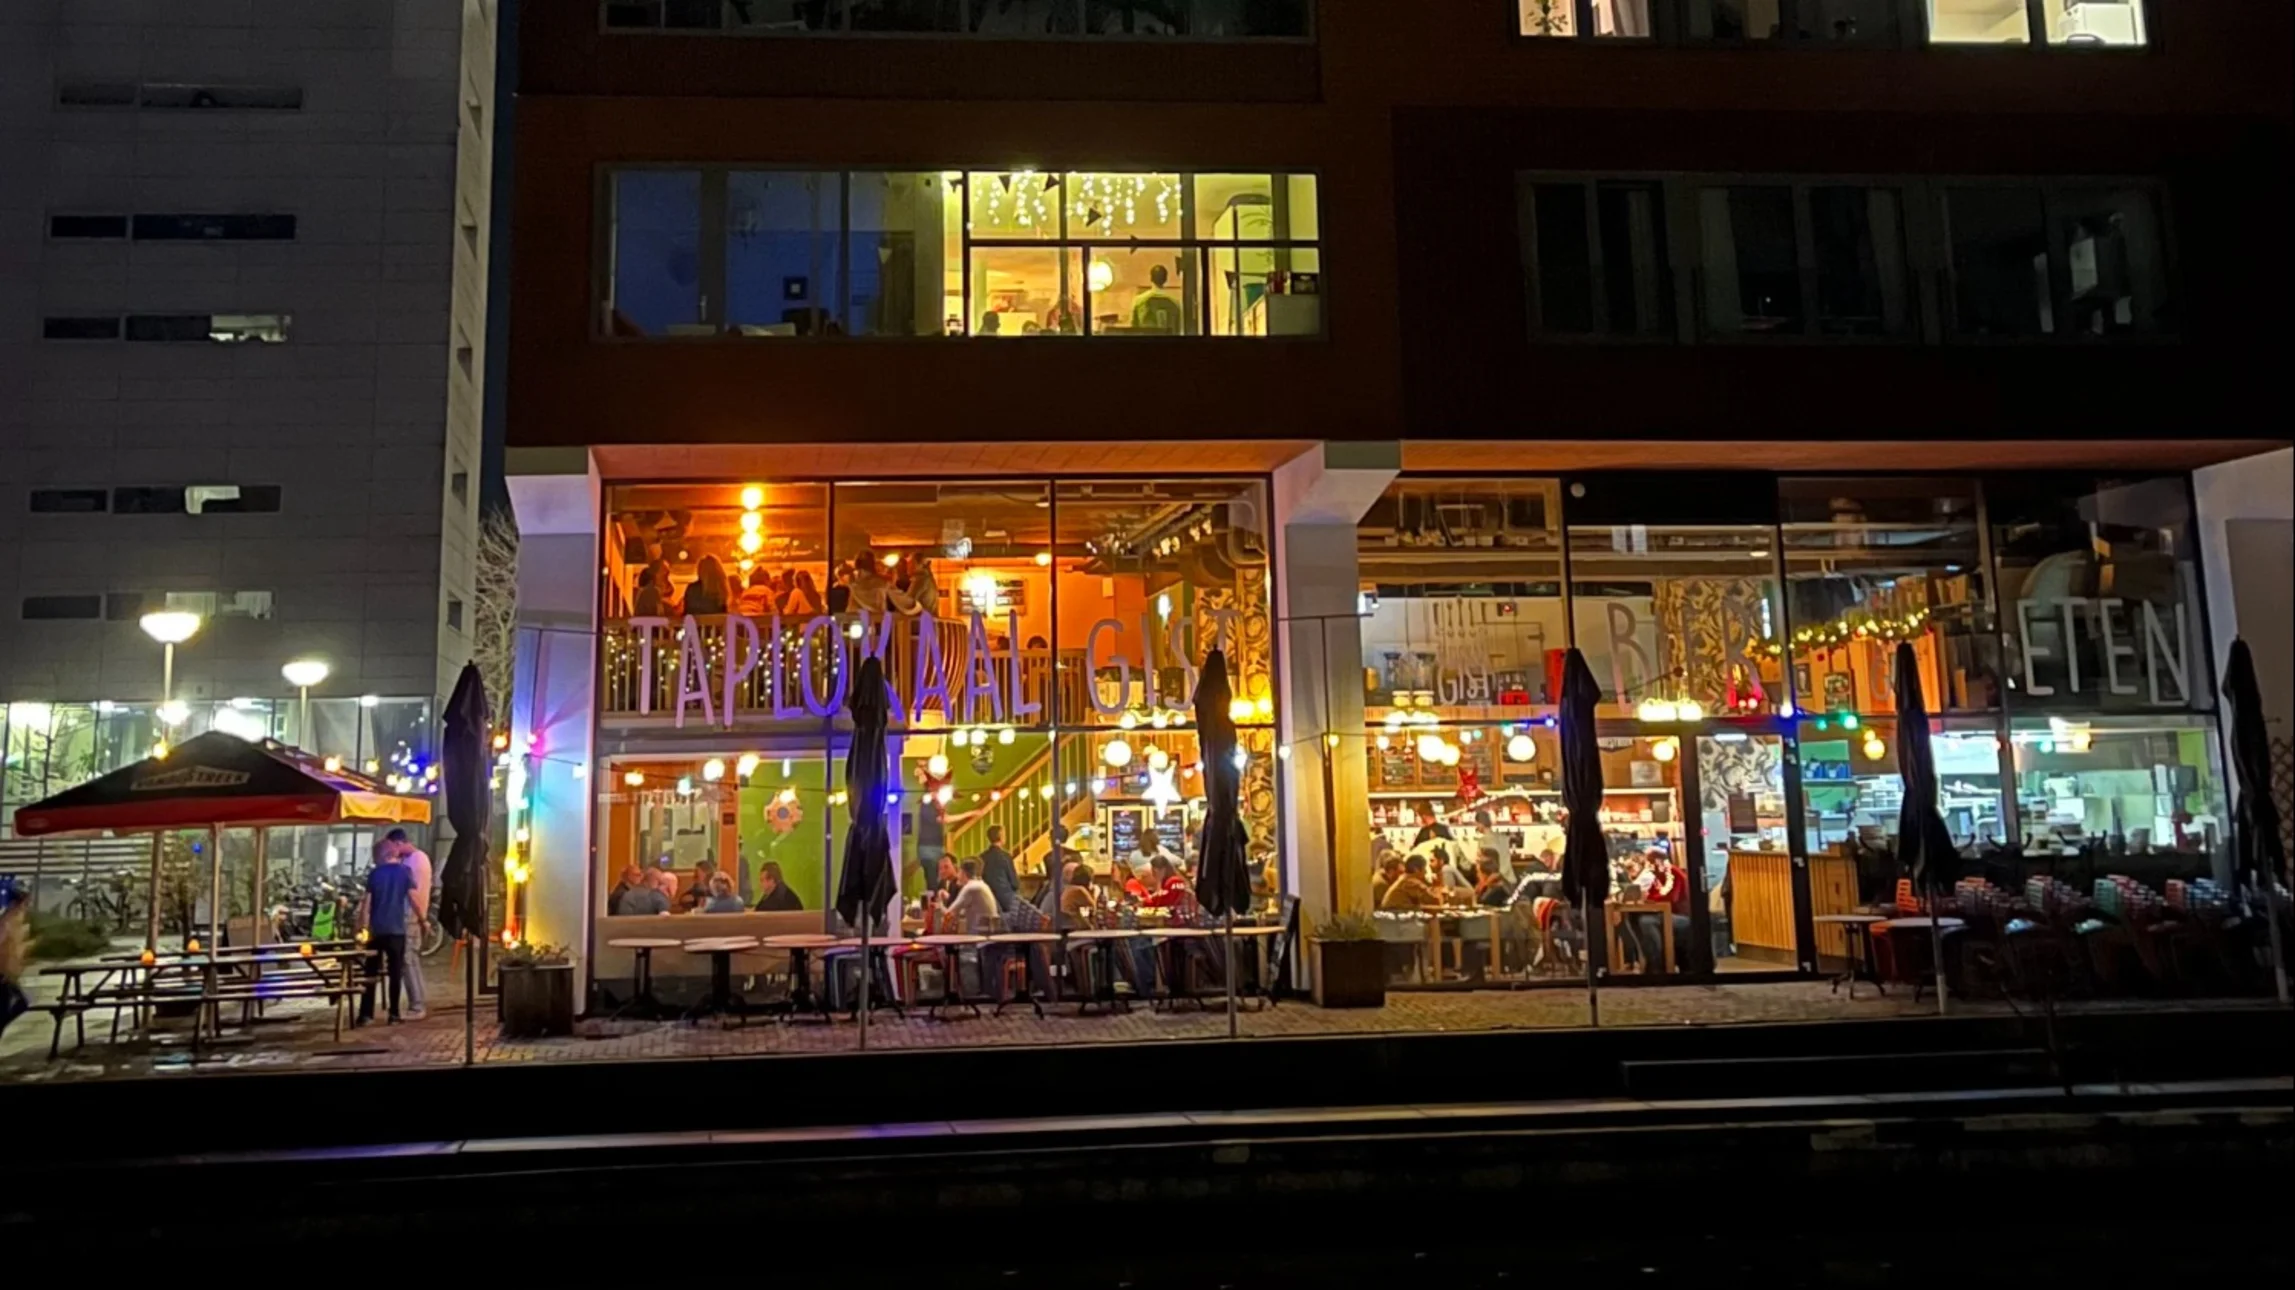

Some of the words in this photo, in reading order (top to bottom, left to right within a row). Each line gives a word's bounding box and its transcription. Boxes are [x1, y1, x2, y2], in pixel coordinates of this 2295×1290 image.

[628, 609, 1042, 728] TAPLOKAAL
[1607, 597, 1767, 714] BIER
[2018, 597, 2191, 706] ETEN
